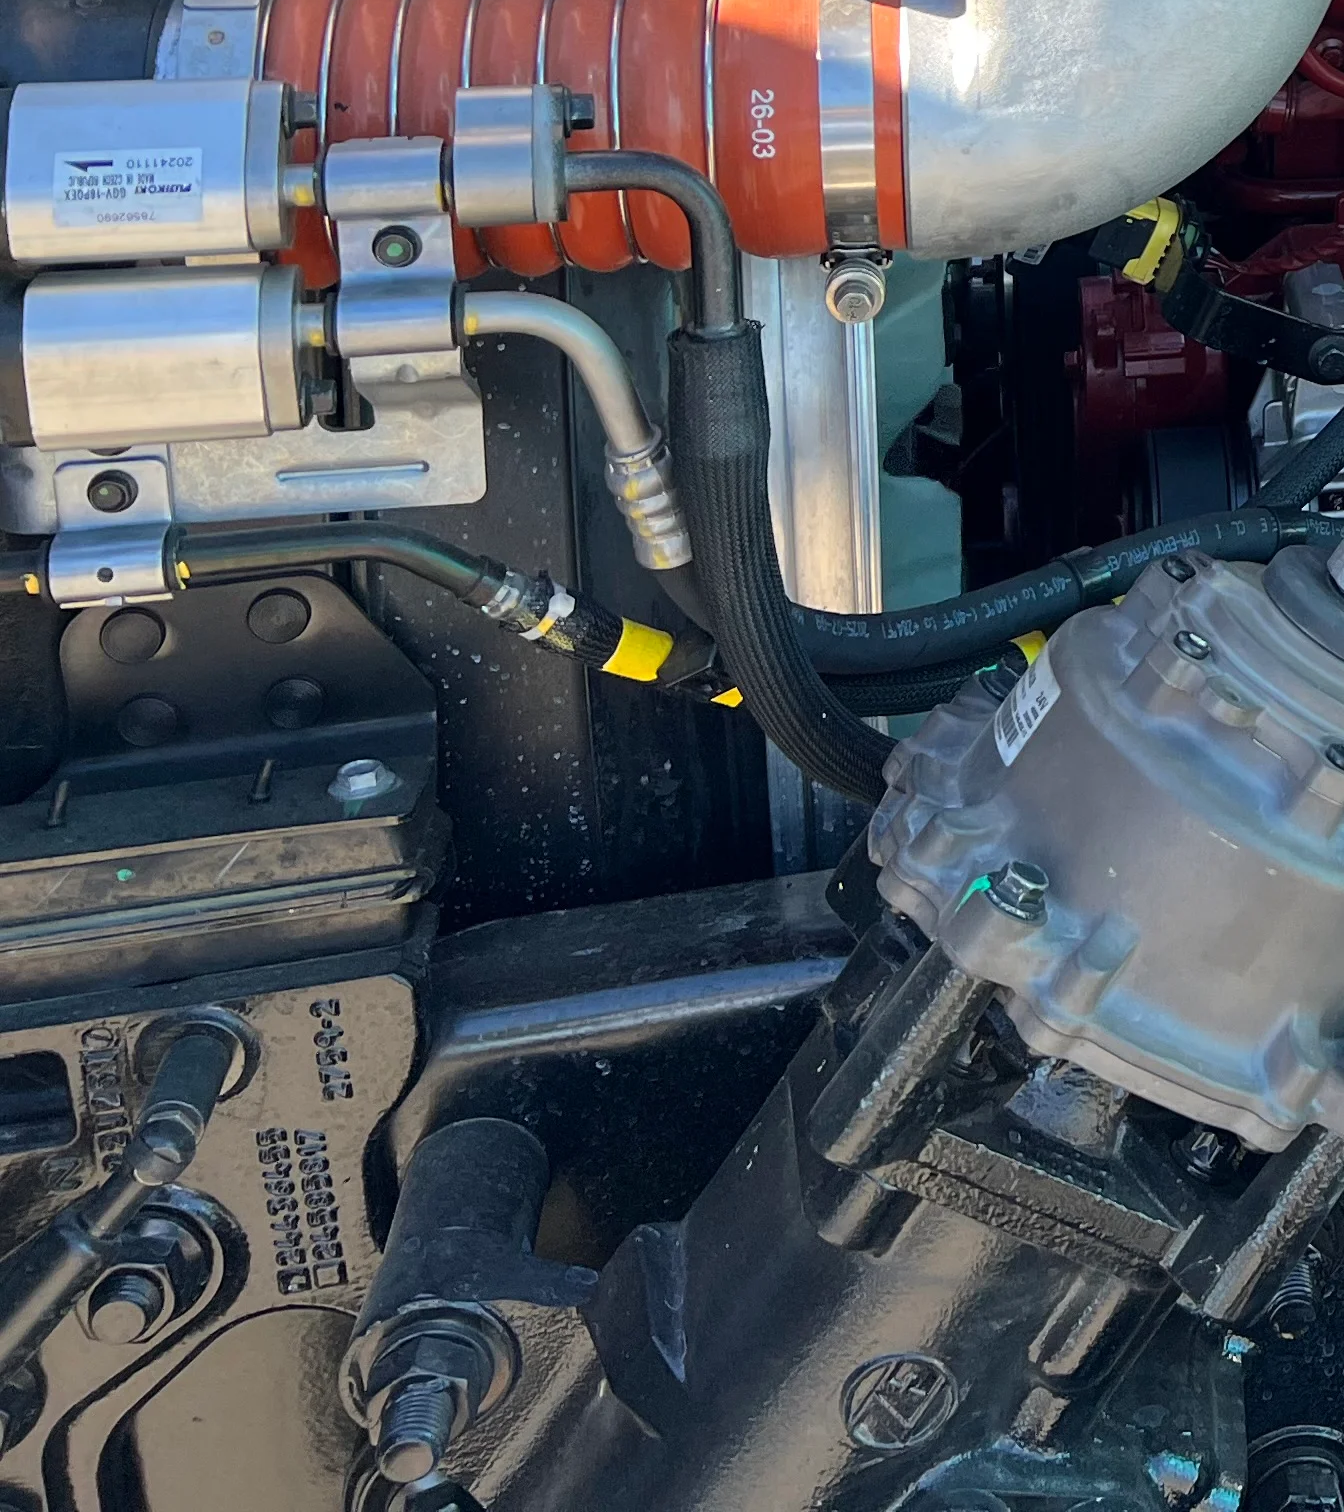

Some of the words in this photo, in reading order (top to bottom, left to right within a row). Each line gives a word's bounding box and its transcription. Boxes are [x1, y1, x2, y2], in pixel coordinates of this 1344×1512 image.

[751, 89, 776, 159] 26-03
[126, 157, 193, 169] 20241110
[135, 183, 192, 193] FUJIKOKI
